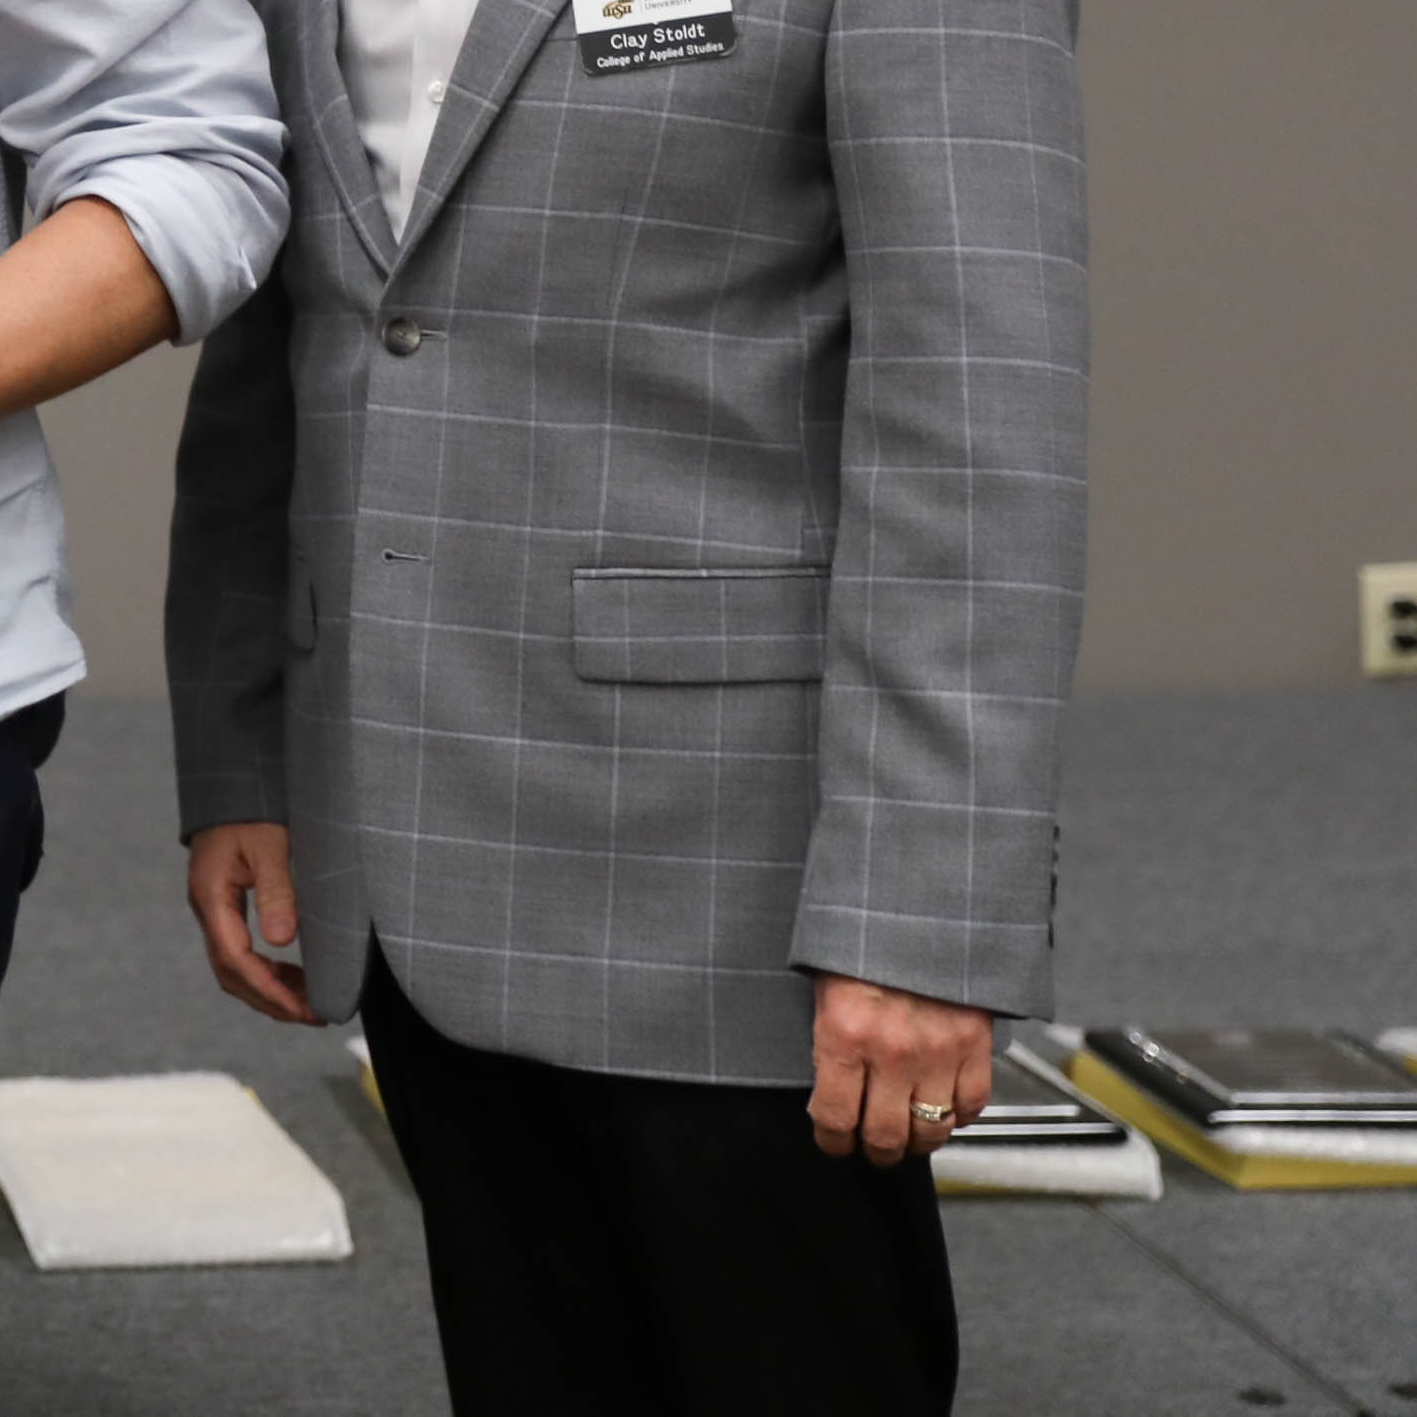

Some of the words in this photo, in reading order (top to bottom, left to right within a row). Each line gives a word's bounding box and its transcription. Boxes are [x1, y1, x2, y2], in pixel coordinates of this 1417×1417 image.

[610, 33, 647, 49] Clay
[653, 23, 706, 43] Stoldt
[596, 54, 631, 68] College
[633, 52, 646, 62] of
[649, 46, 685, 61] Applied
[687, 42, 725, 55] Studies
